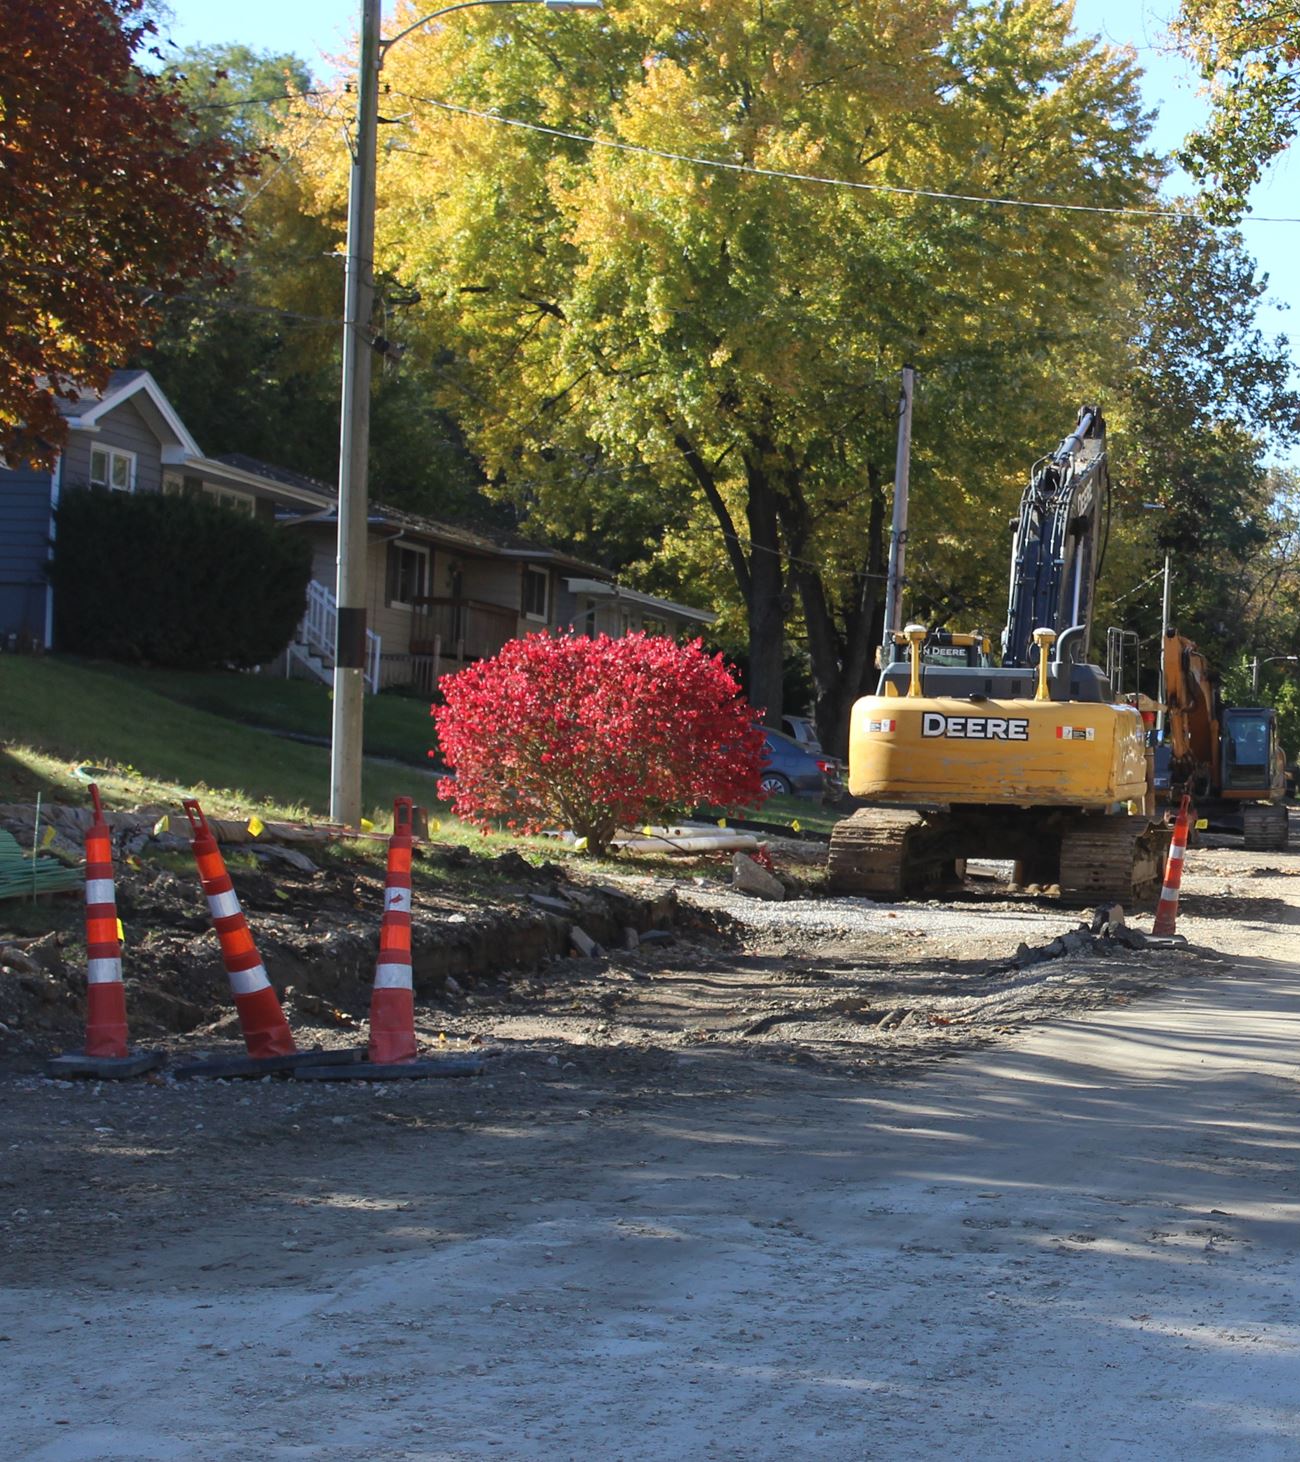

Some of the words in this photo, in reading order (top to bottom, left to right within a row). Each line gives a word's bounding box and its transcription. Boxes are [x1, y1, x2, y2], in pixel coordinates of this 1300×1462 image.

[903, 645, 930, 655] JN
[932, 646, 967, 656] DEERE
[922, 712, 1029, 740] DEERE
